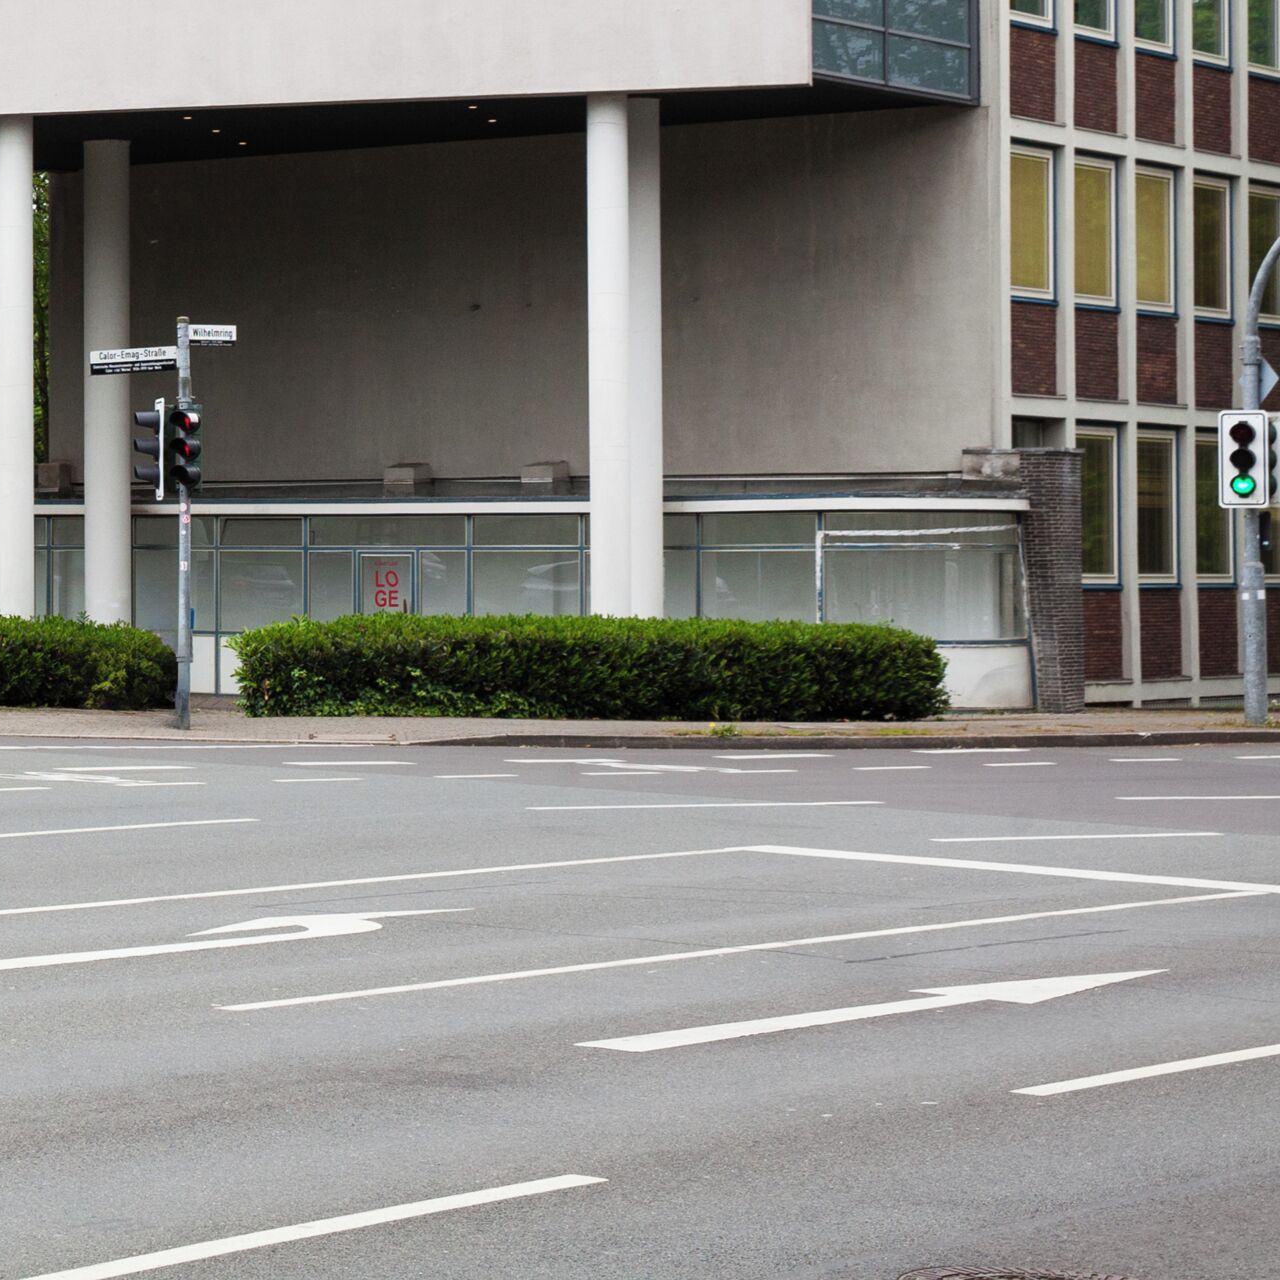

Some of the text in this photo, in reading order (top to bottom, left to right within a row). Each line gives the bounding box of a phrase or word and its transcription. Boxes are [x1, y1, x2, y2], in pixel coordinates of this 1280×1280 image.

[192, 327, 233, 339] Wilhelmring
[99, 349, 167, 361] Calor-Emag-Straße
[375, 570, 399, 587] LO
[374, 589, 399, 608] GE
